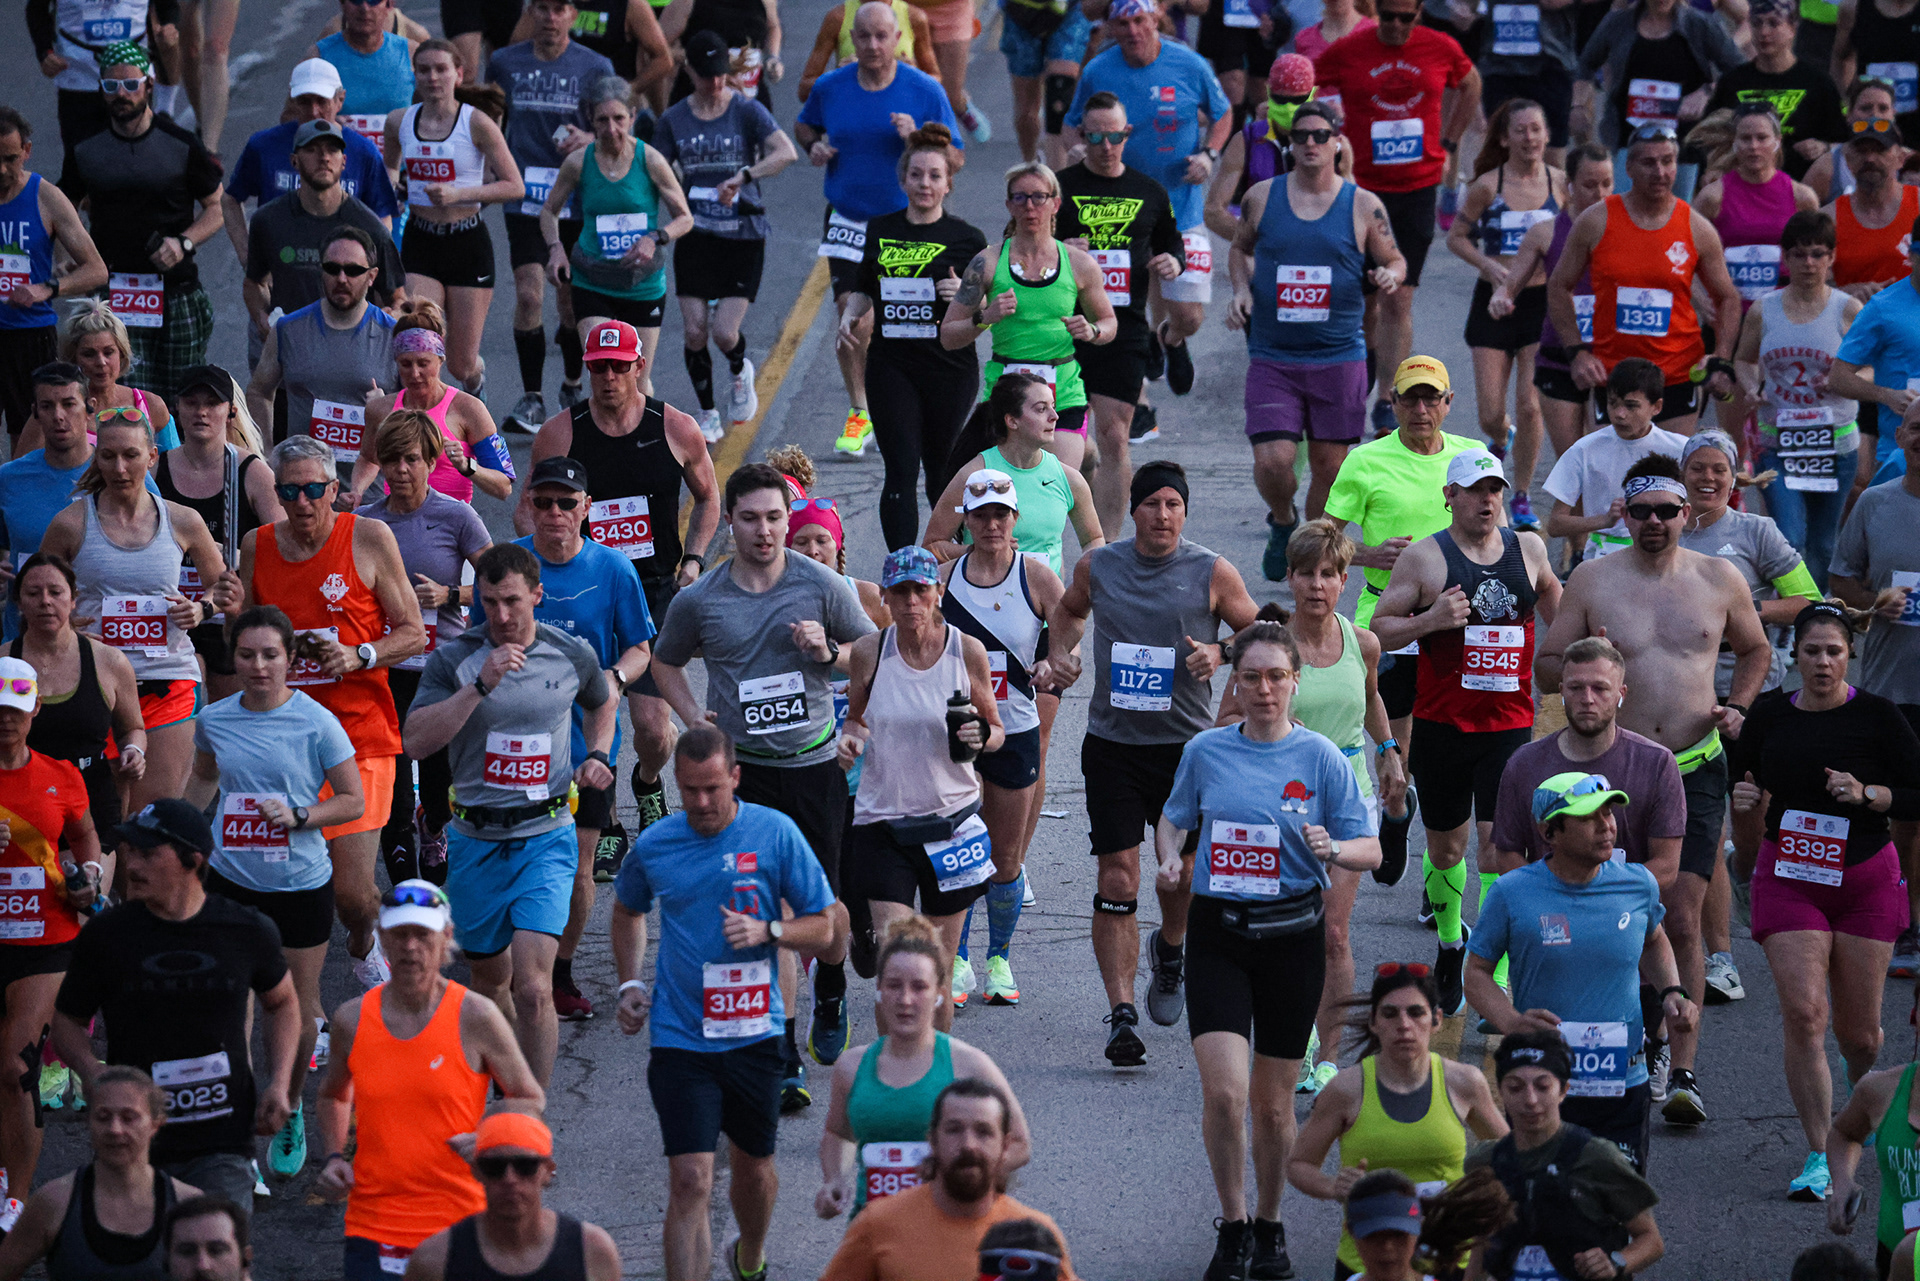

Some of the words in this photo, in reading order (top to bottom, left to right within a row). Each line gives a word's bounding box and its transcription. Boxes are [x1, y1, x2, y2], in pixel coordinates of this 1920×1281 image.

[91, 21, 124, 36] 659
[1376, 139, 1418, 155] 1047
[411, 162, 450, 178] 4316
[412, 217, 447, 237] NIKE
[449, 218, 478, 234] PRO
[826, 227, 866, 247] 6019
[1730, 266, 1775, 282] 1489
[112, 293, 160, 308] 2740
[1279, 288, 1327, 303] 4037
[883, 304, 933, 320] 6026
[1622, 309, 1663, 327] 1331
[1791, 361, 1808, 387] 2
[315, 424, 361, 444] 3215
[1779, 430, 1832, 447] 6022
[1784, 457, 1834, 474] 6022
[592, 519, 648, 543] 3430
[104, 621, 164, 639] 3803
[1466, 651, 1520, 670] 3545
[1119, 669, 1163, 690] 1172
[744, 698, 805, 724] 6054
[487, 759, 547, 779] 4458
[224, 820, 286, 839] 4442
[942, 841, 986, 872] 928
[1213, 848, 1276, 870] 3029
[1780, 836, 1842, 863] 3392
[710, 990, 765, 1014] 3144
[1572, 1052, 1617, 1073] 104
[868, 1172, 922, 1195] 385
